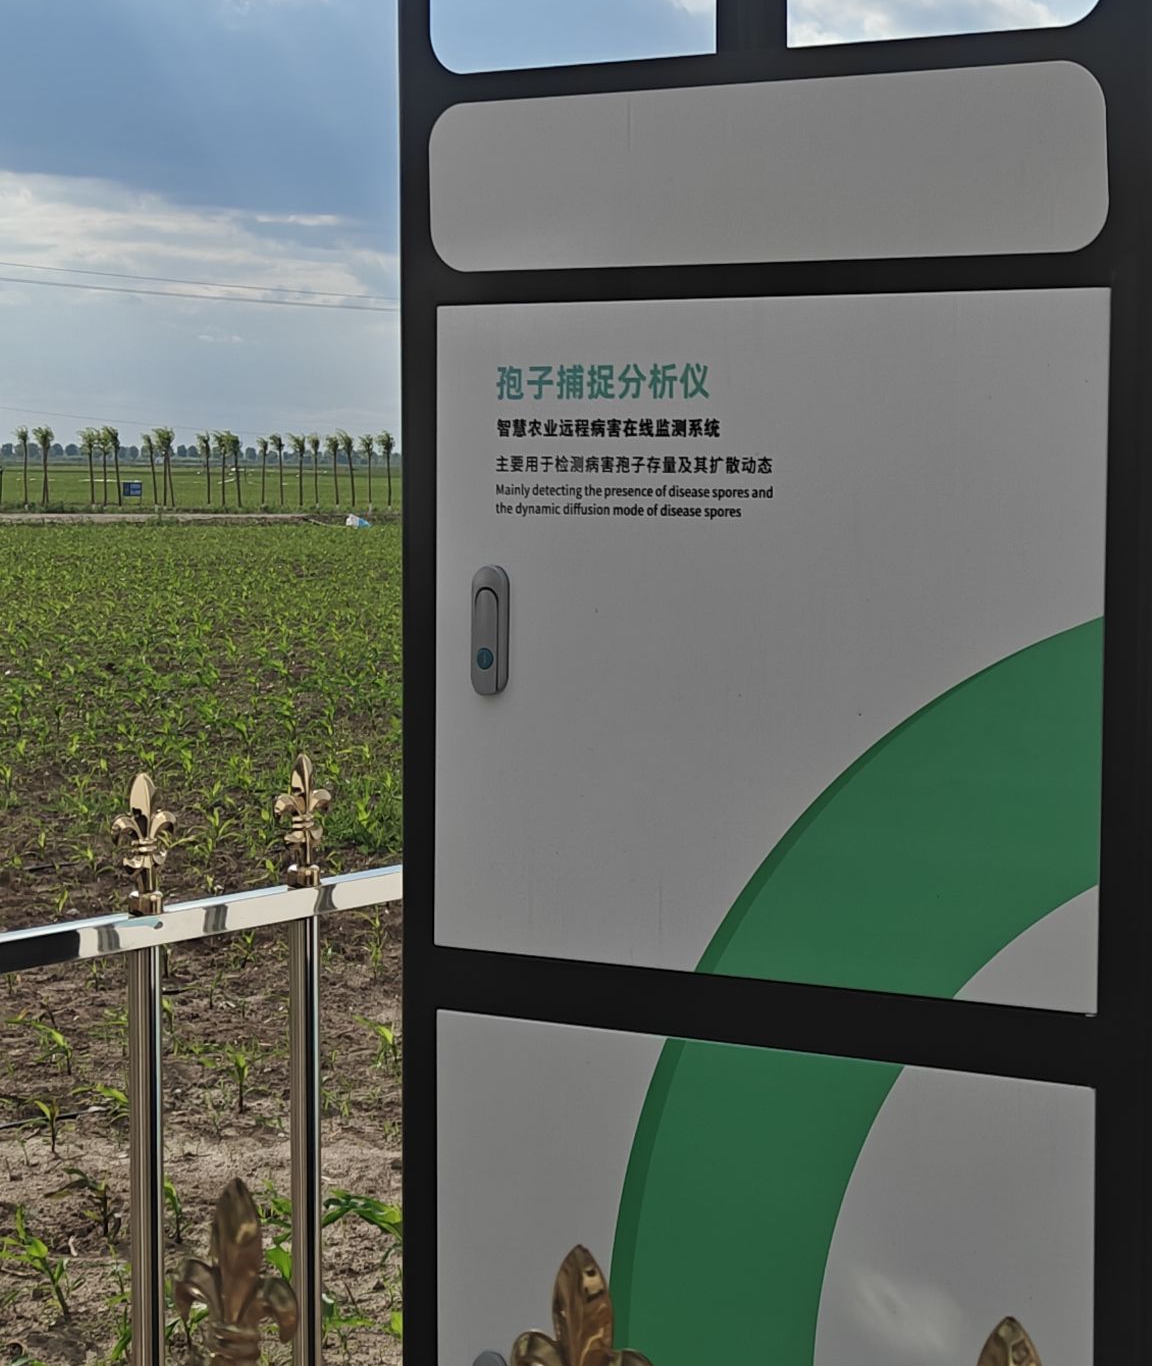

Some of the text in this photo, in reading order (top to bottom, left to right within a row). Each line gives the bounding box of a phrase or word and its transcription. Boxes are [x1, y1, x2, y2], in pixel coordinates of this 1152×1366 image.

[496, 363, 710, 400] 孢子捕捉分析仪
[497, 418, 720, 438] 智慧农业远程病害在线监测系统
[496, 454, 773, 474] 主要用于检测病害孢子存量及其扩散动态
[496, 483, 773, 501] Mainly detecting the presence of disease spores and
[496, 502, 742, 520] the dynamic diffusion mode of disease spores
